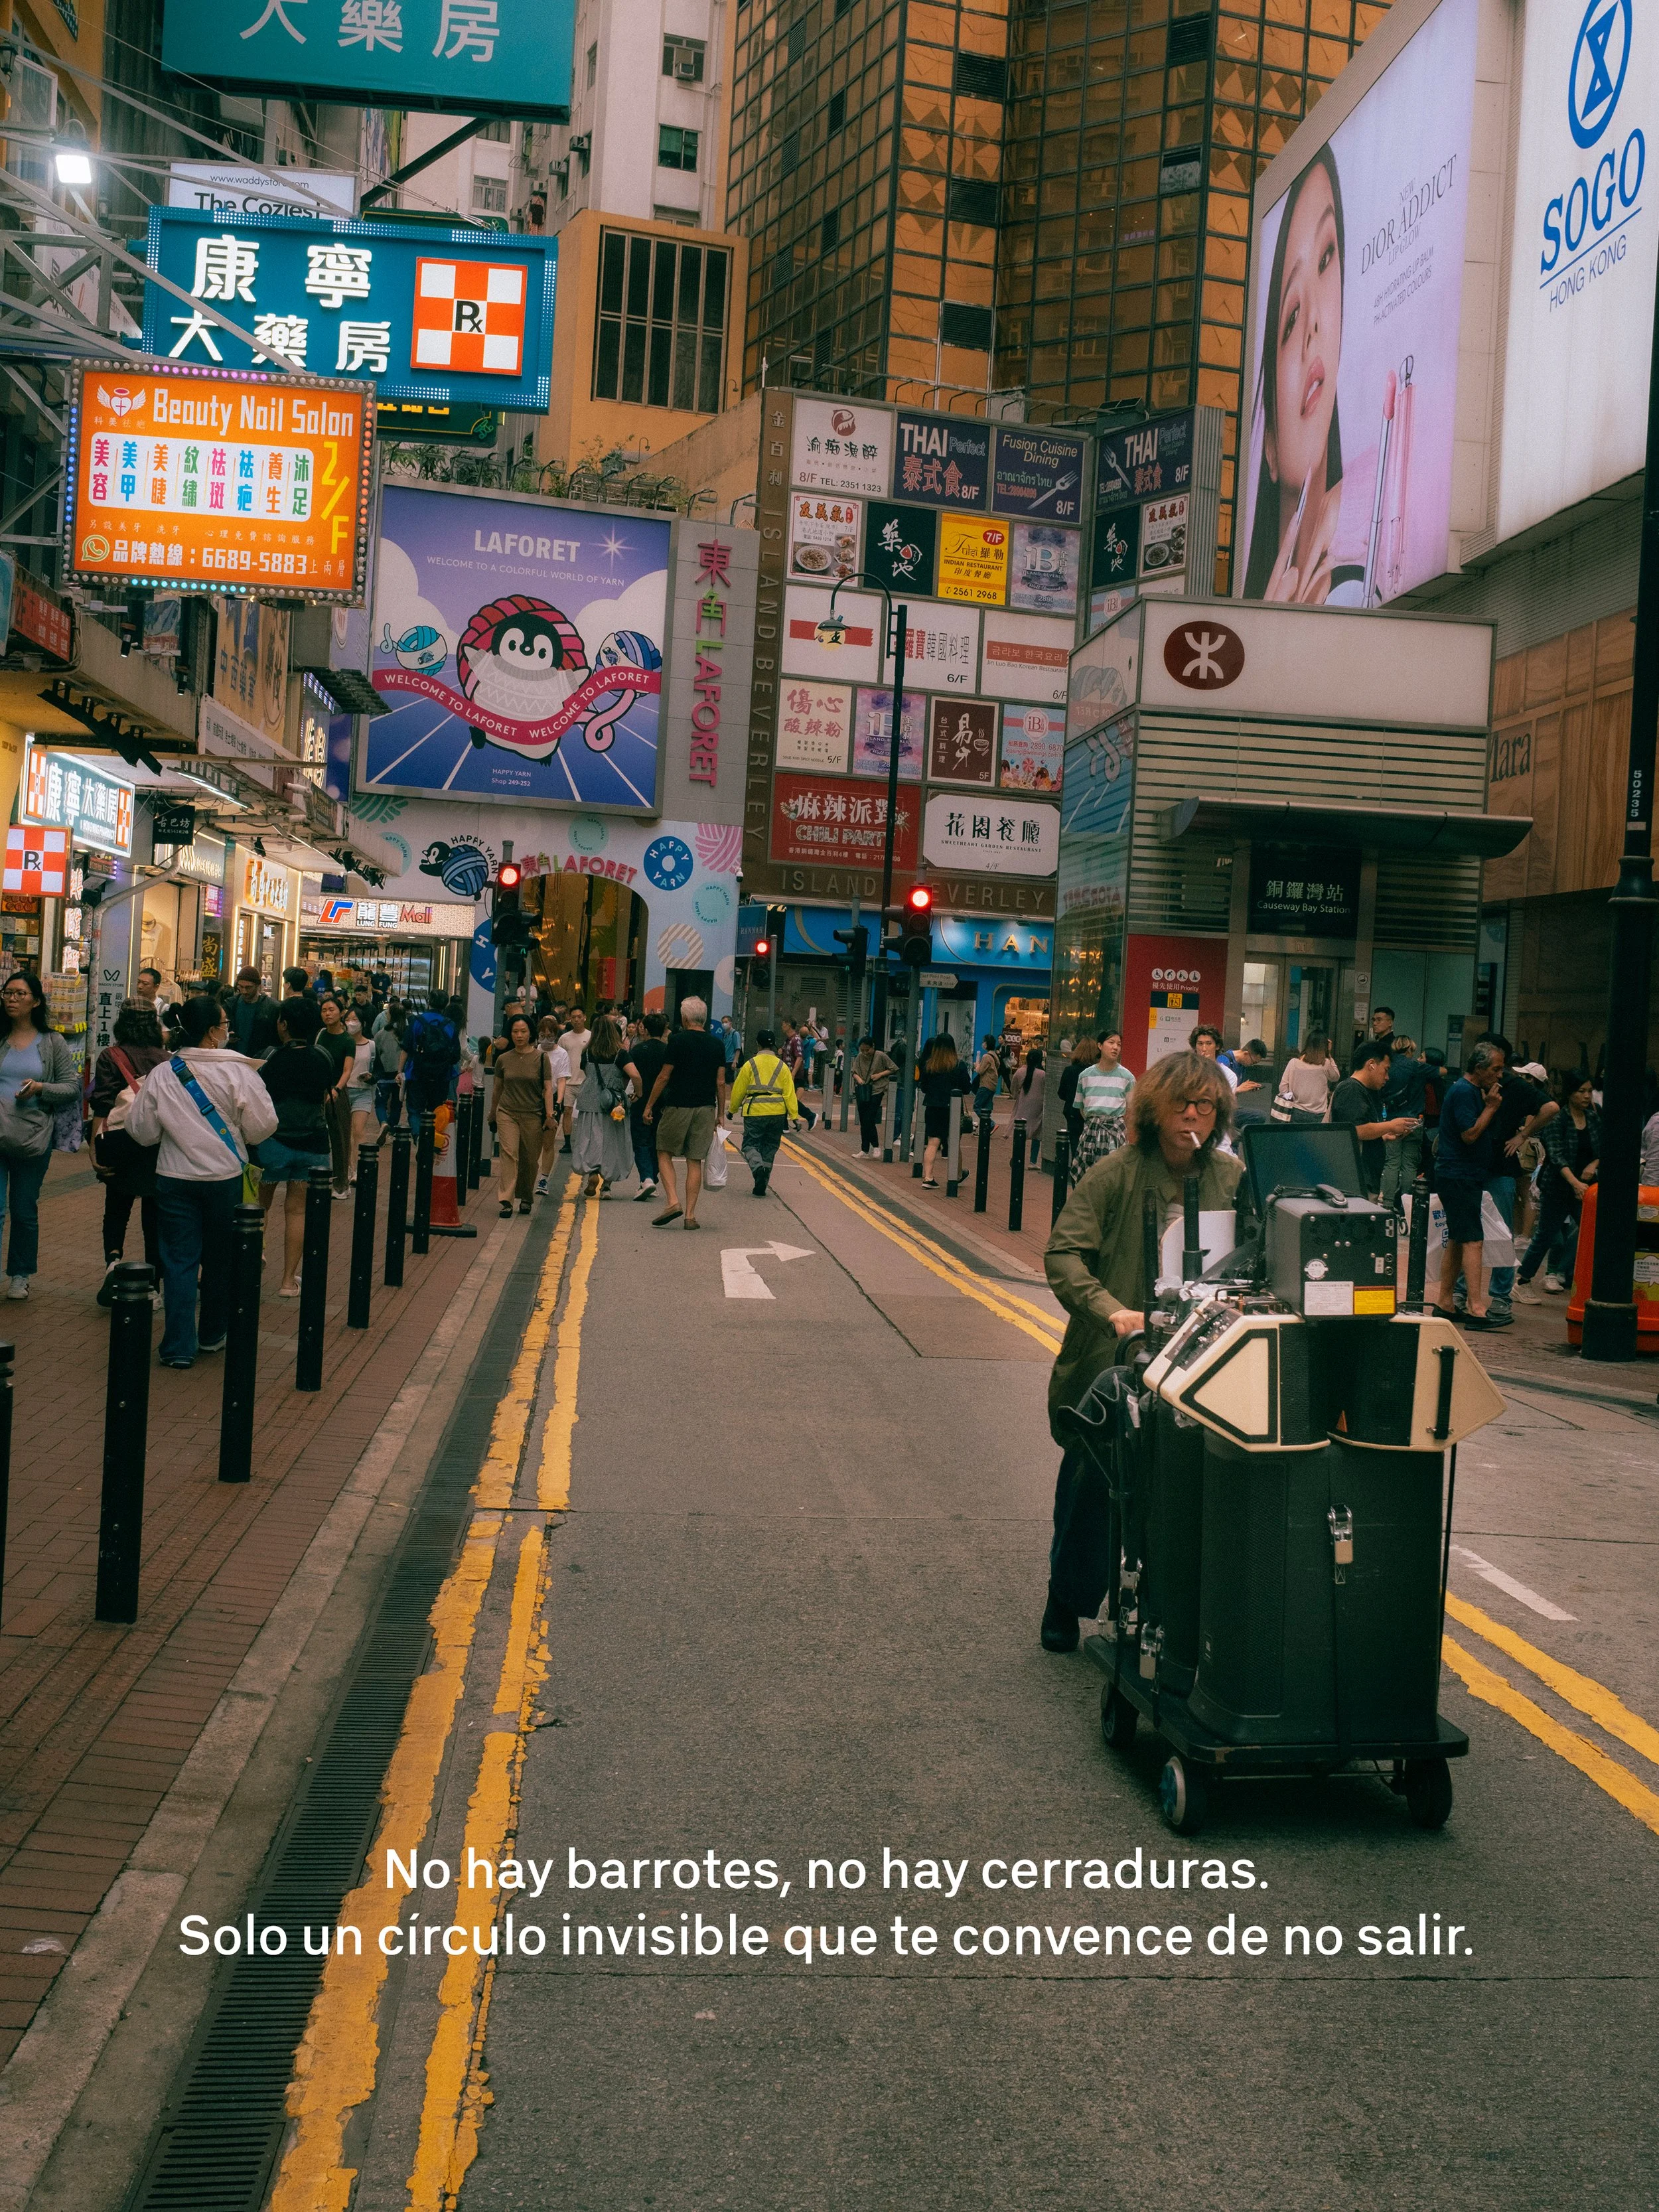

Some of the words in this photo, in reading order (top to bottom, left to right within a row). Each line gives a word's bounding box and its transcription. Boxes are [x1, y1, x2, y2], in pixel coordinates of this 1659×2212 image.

[194, 192, 237, 212] The
[1361, 218, 1396, 276] DIOR
[1398, 153, 1457, 238] ADDICT
[1540, 128, 1646, 275] SOGO
[190, 234, 374, 309] 康寧
[1550, 267, 1585, 313] HONG
[1589, 234, 1626, 283] KONG
[169, 312, 392, 372] 大藥房
[153, 388, 233, 436] Beauty
[240, 395, 285, 433] Nail
[291, 400, 354, 437] Salon
[768, 410, 786, 486] 金百利
[900, 422, 948, 457] THAI
[949, 437, 985, 457] Perfect
[1002, 435, 1037, 452] Fusion
[1040, 440, 1078, 457] Cuisine
[1124, 427, 1159, 469] THAI
[93, 439, 110, 500] 美容
[121, 441, 137, 502] 美甲
[1023, 451, 1059, 469] Dining
[1175, 464, 1189, 483] 8/F
[266, 452, 283, 514] 養生
[292, 455, 310, 516] 沐足
[799, 472, 817, 483] 8/F
[820, 477, 838, 486] TEL:
[840, 480, 859, 489] 2351
[862, 483, 881, 492] 1323
[902, 454, 963, 498] 泰式食
[961, 484, 979, 500] 8/F
[1056, 500, 1075, 516] 8/F
[474, 530, 581, 563] LAFORET
[986, 532, 1003, 544] 7/F
[202, 548, 307, 575] 6689-5883
[427, 556, 472, 570] WELCOME
[475, 561, 488, 571] TO
[490, 563, 497, 572] A
[499, 565, 548, 579] COLORFUL
[550, 570, 585, 581] WORLD
[586, 574, 599, 583] OF
[599, 577, 624, 586] YARN
[758, 510, 782, 640] ISLAND
[966, 561, 1003, 571] RESTAURANT
[953, 587, 973, 597] 2561
[976, 589, 997, 600] 2968
[1025, 649, 1062, 663] 한국요리
[1039, 665, 1067, 674] Restaurant
[947, 674, 968, 684] 6/F
[384, 674, 445, 701] WELCOME
[448, 698, 464, 711] TO
[465, 707, 518, 737] LAFORET
[529, 701, 581, 739] WELCOME
[579, 686, 595, 701] TO
[595, 672, 650, 691] LAFORET
[787, 688, 844, 715] 傷心
[1052, 690, 1068, 700] 6/F
[689, 640, 723, 787] LAFORET
[784, 717, 843, 738] 酸辣粉
[747, 658, 774, 841] BEVERLEY
[827, 755, 842, 764] 5/F
[979, 771, 989, 780] 5F
[1630, 770, 1642, 818] 50235
[157, 817, 190, 828] 古巴坊
[649, 841, 689, 861] HAPPY
[842, 828, 889, 848] PART
[451, 834, 484, 848] HAPPY
[484, 846, 499, 875] YARN
[553, 854, 638, 884] LAFORET
[653, 871, 685, 887] YARN
[781, 869, 877, 897] ISLAND
[932, 884, 1046, 911] EVERLEY
[1265, 880, 1344, 902] 銅鑼灣站
[399, 904, 432, 924] Mall
[1257, 900, 1301, 913] Causeway
[1302, 903, 1318, 914] Bay
[1320, 904, 1350, 914] Station
[740, 926, 763, 935] HANNAH
[1152, 982, 1180, 990] 優先使用
[97, 992, 112, 1047] 直上1樓
